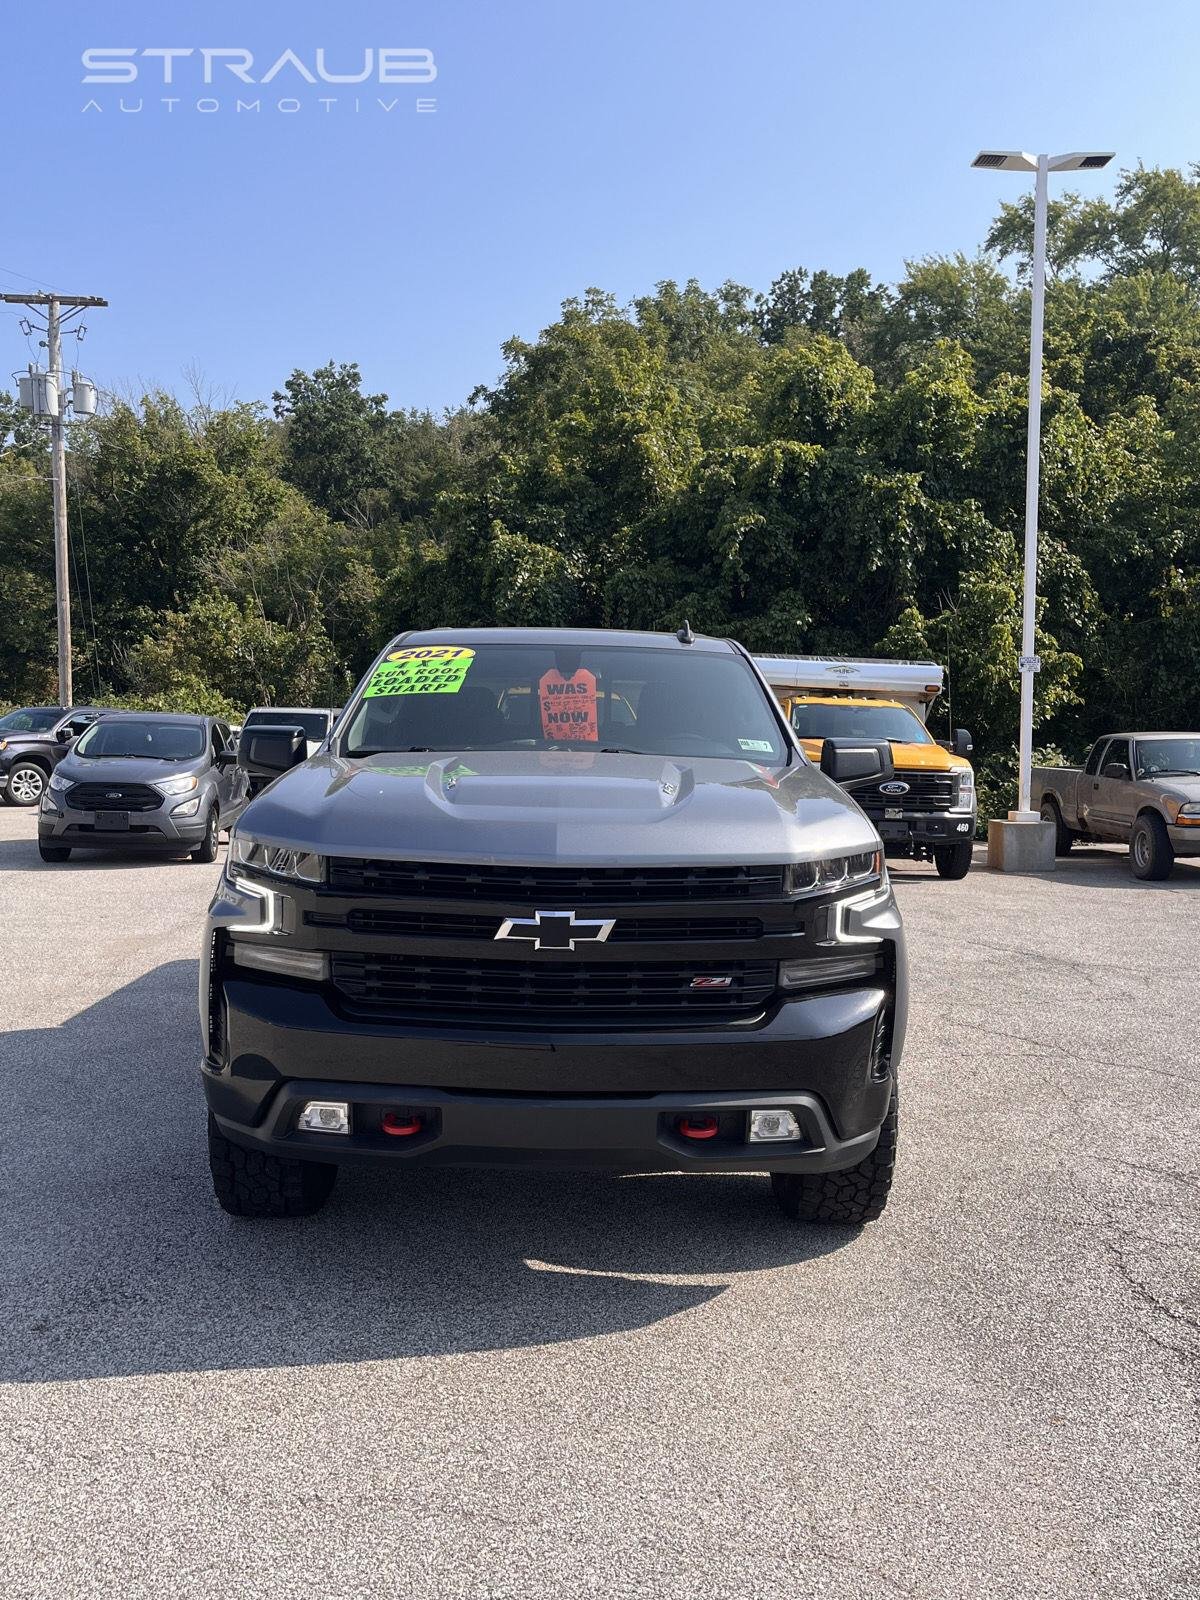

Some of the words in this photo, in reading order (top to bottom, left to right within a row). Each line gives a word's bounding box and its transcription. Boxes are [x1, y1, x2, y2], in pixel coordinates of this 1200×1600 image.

[397, 649, 464, 660] 2021
[373, 669, 410, 679] SUN
[414, 667, 465, 675] ROOF
[371, 674, 461, 687] LOADED
[373, 683, 448, 695] SHARP
[546, 682, 588, 695] WAS
[547, 711, 589, 723] NOW
[956, 823, 969, 832] 460
